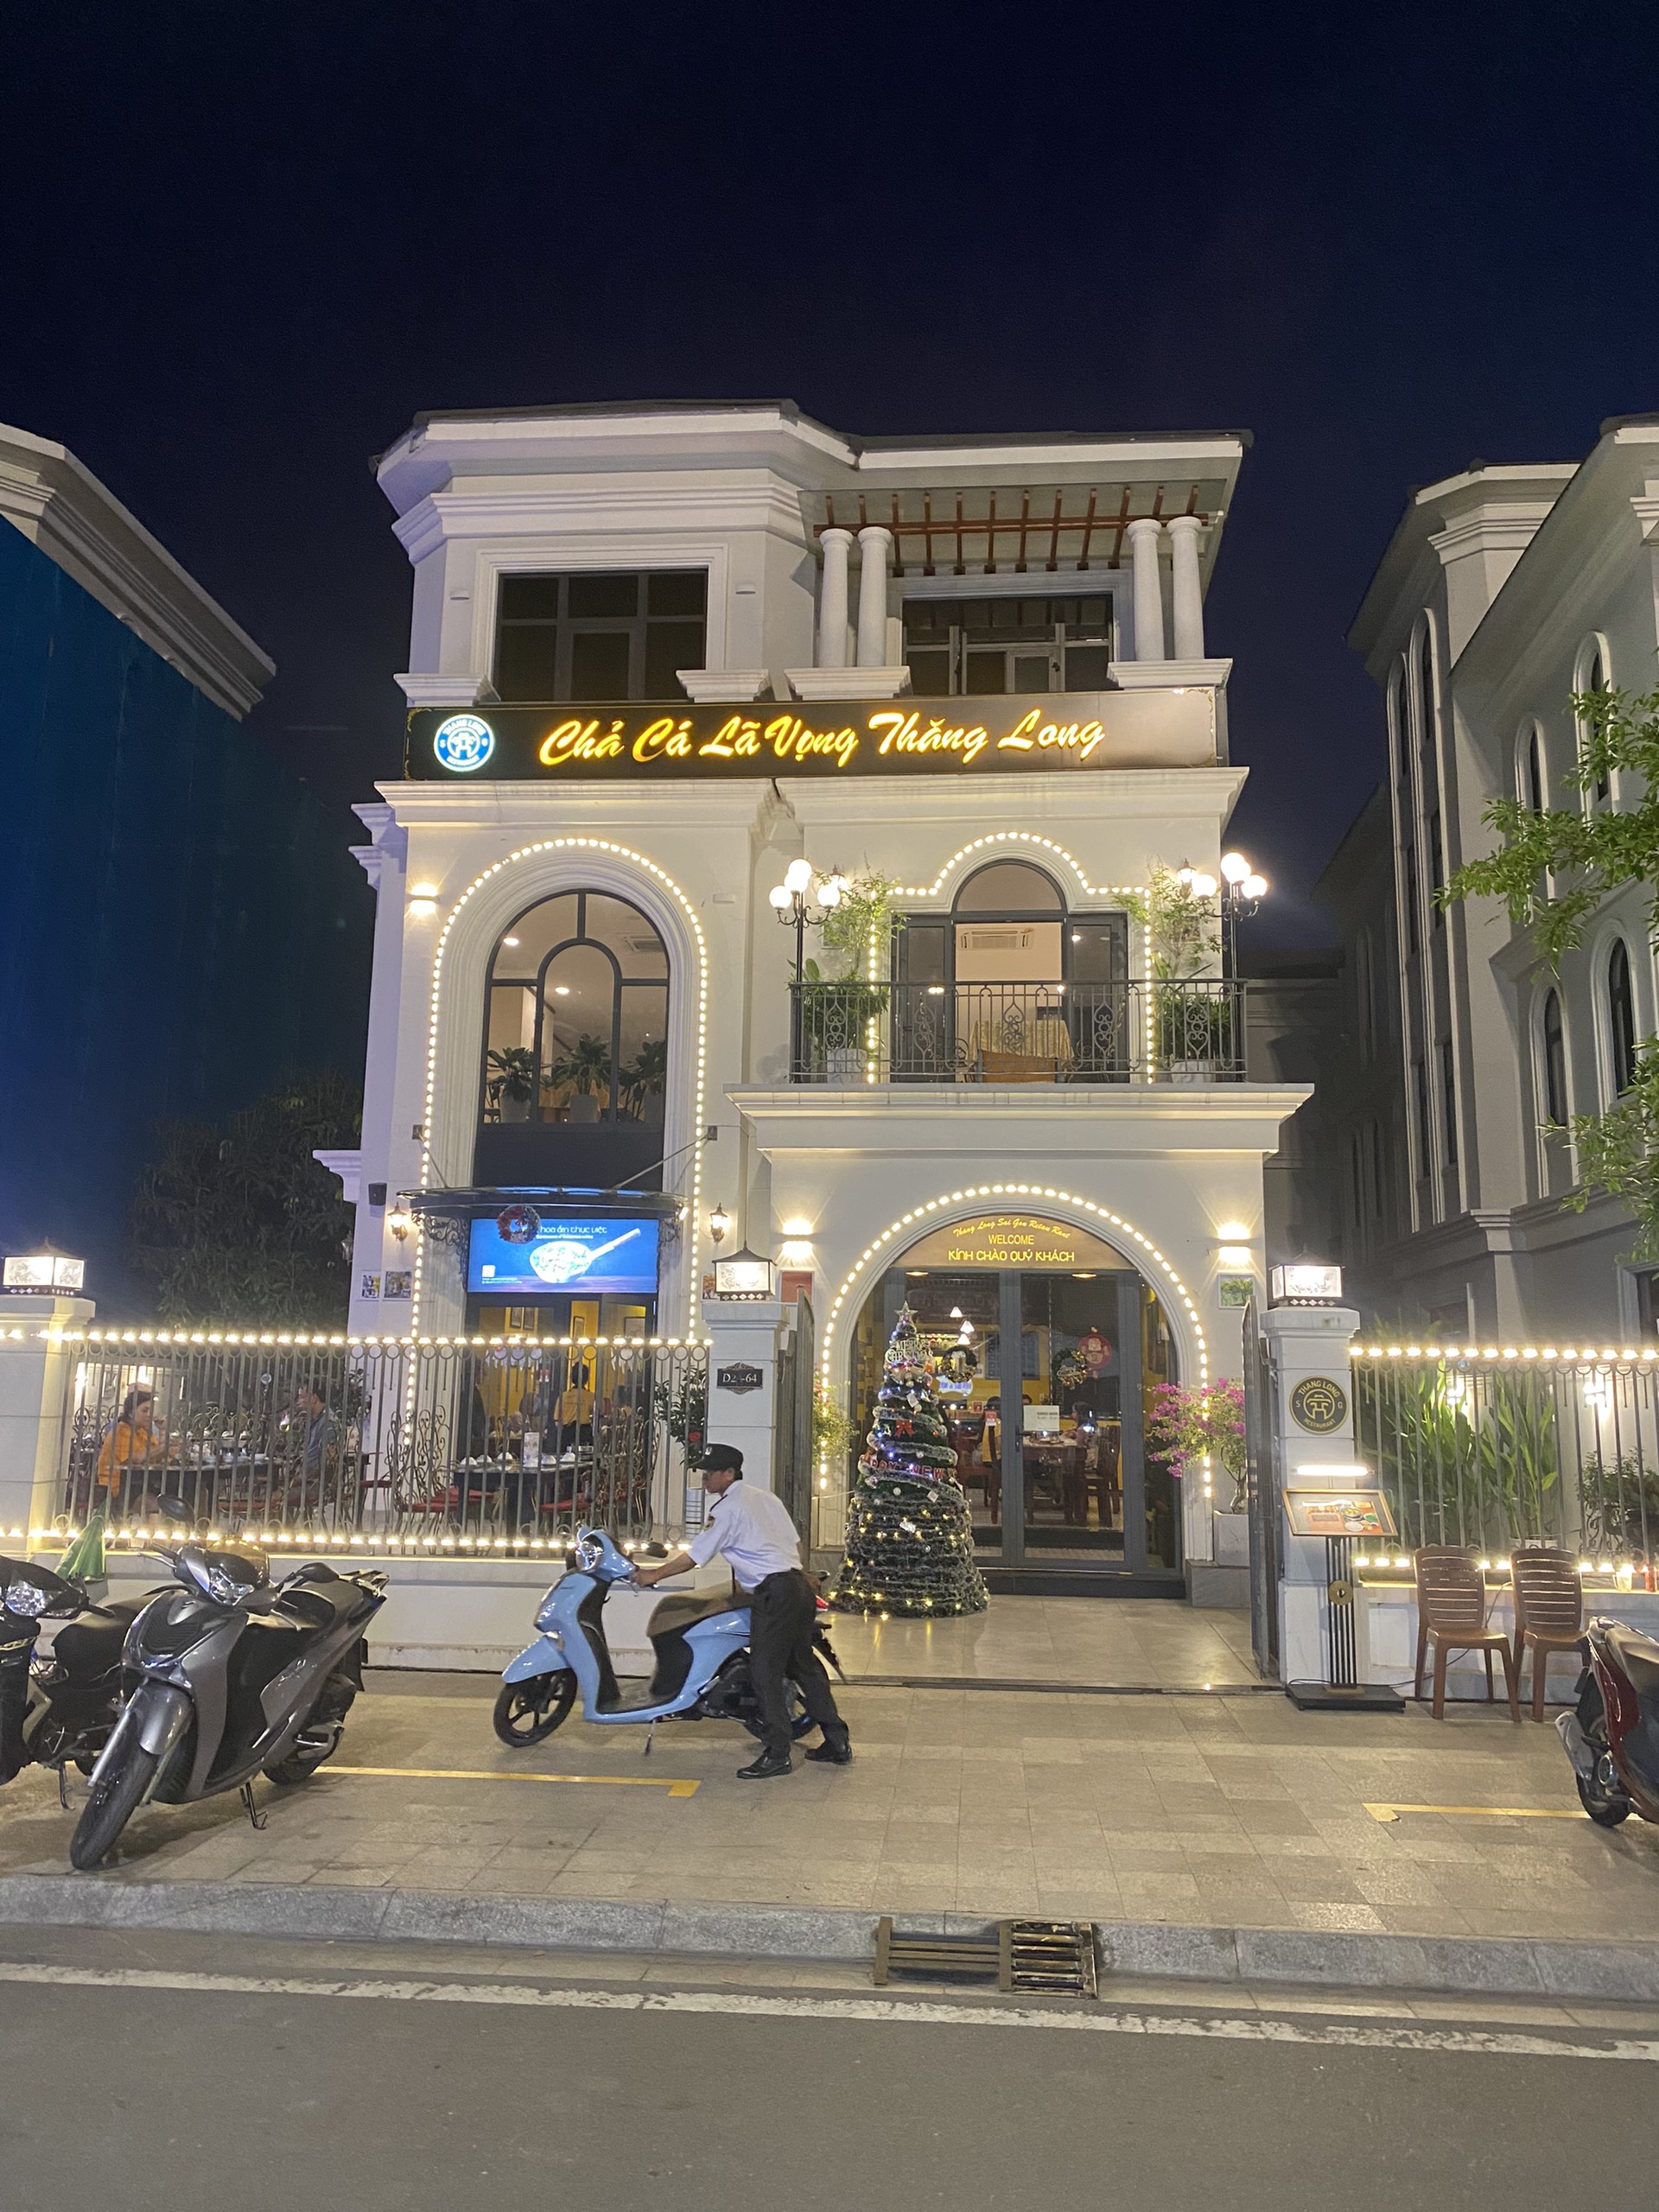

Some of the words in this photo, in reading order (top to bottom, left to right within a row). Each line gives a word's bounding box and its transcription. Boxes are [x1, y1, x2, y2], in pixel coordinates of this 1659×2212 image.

[539, 719, 625, 766] Chả
[632, 718, 693, 763] Cá
[698, 715, 761, 757] Lã
[764, 715, 860, 768] Vọng
[868, 711, 988, 765] Thăng
[997, 708, 1106, 761] Long
[988, 1235, 1034, 1245] WELCOME
[948, 1248, 974, 1261] KÍNH
[976, 1249, 1007, 1262] CHÀO
[1010, 1248, 1033, 1262] QUÝ
[1035, 1249, 1075, 1262] KHÁCH
[1298, 1380, 1321, 1395] THANG
[1322, 1381, 1340, 1397] LONG
